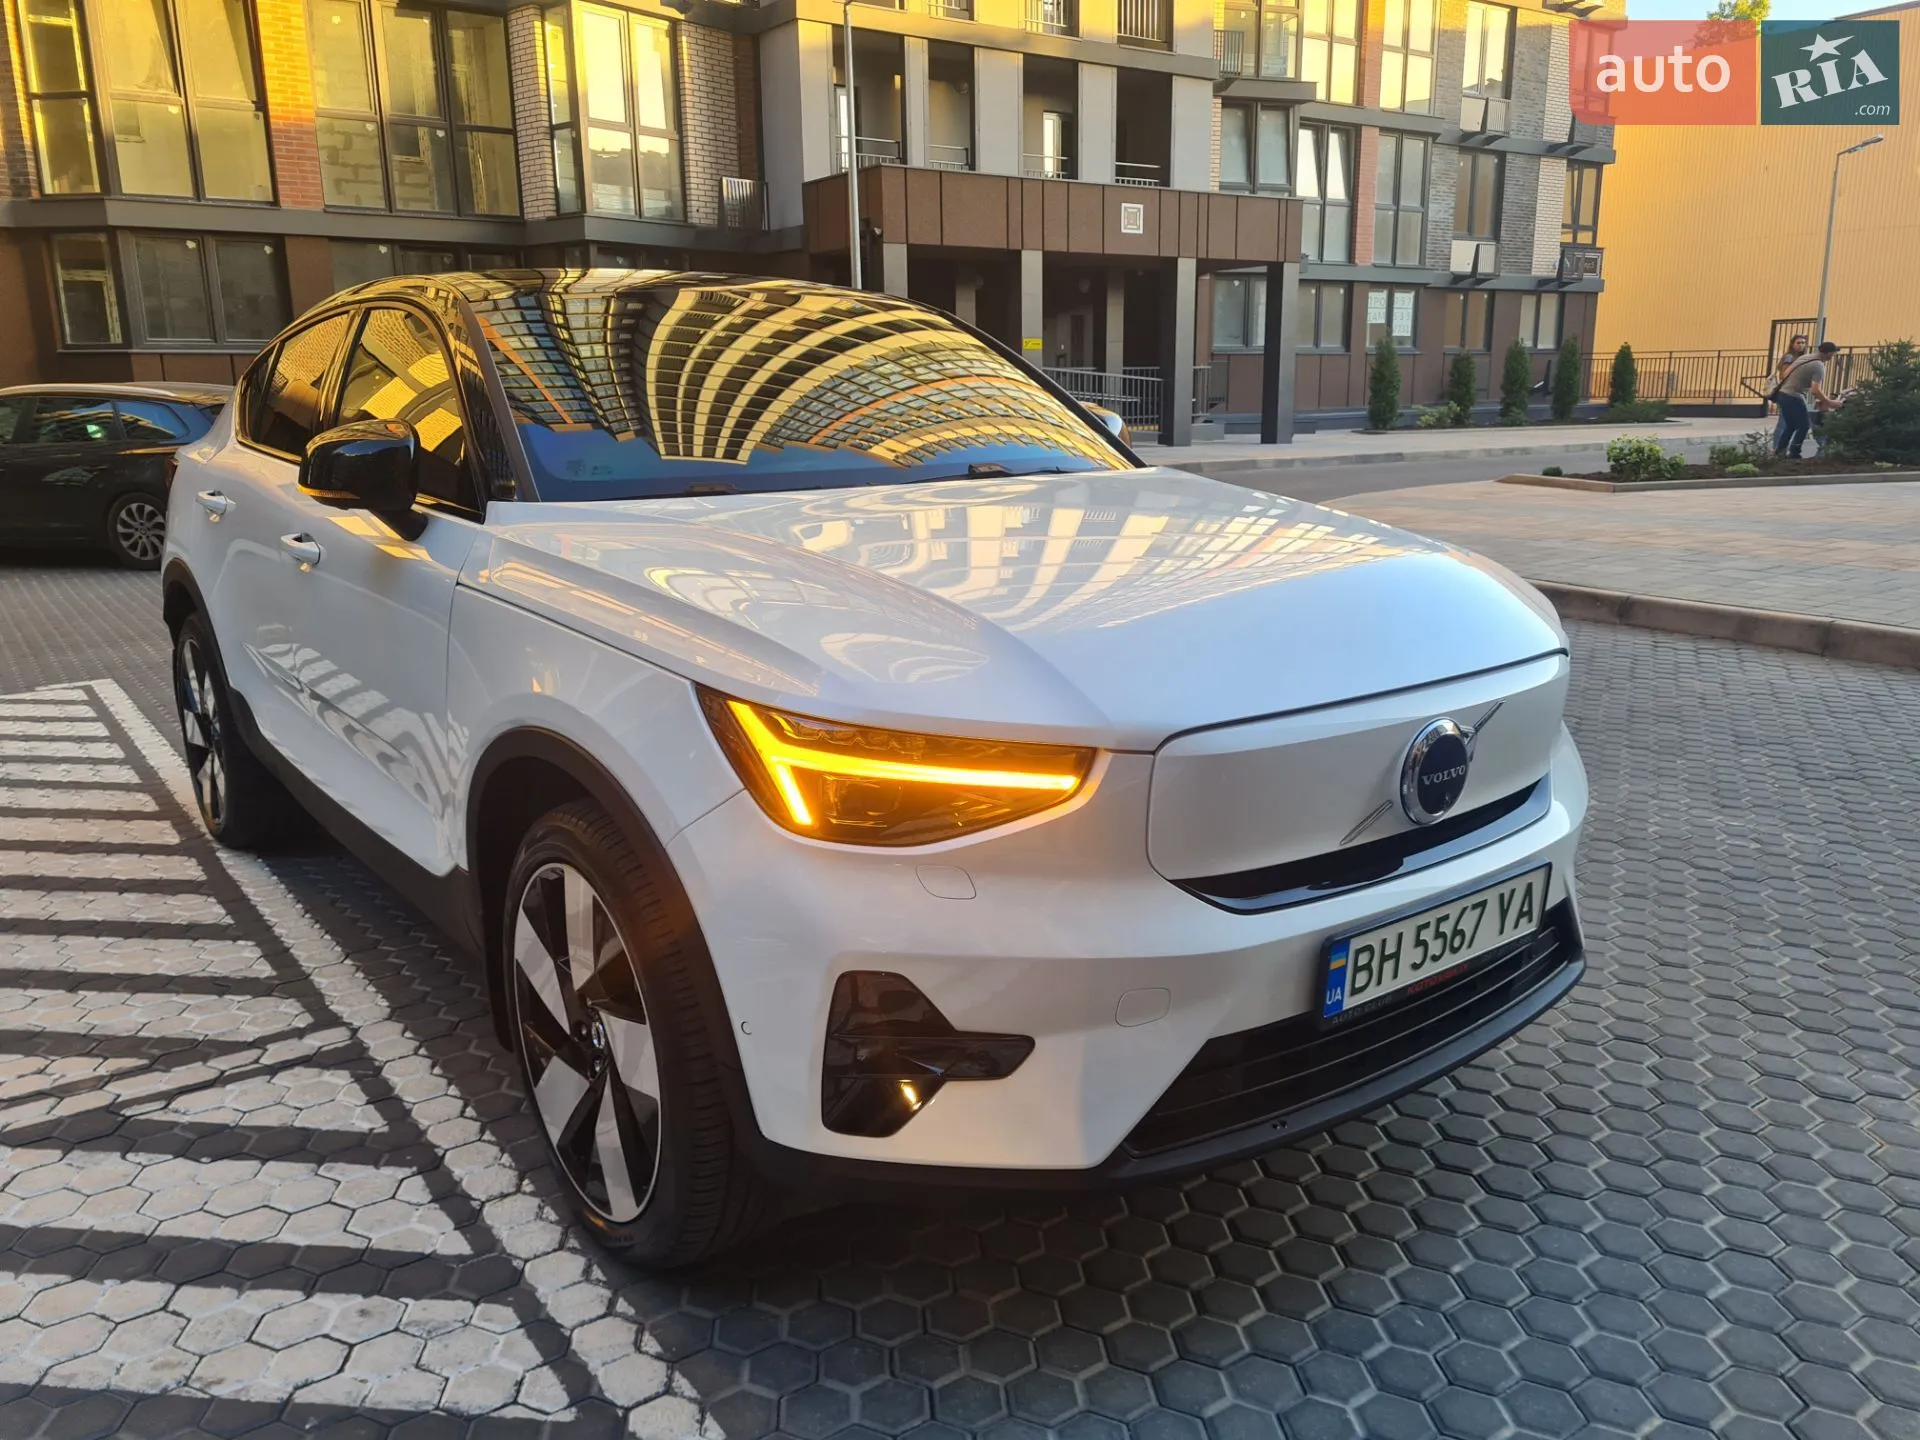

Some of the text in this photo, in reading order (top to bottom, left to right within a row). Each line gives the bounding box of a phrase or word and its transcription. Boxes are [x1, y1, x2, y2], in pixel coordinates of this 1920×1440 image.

[1422, 765, 1466, 786] VOLVO
[1350, 931, 1404, 997] BH
[1410, 899, 1488, 971] 5567
[1498, 881, 1533, 937] YA
[1326, 986, 1342, 1005] UA
